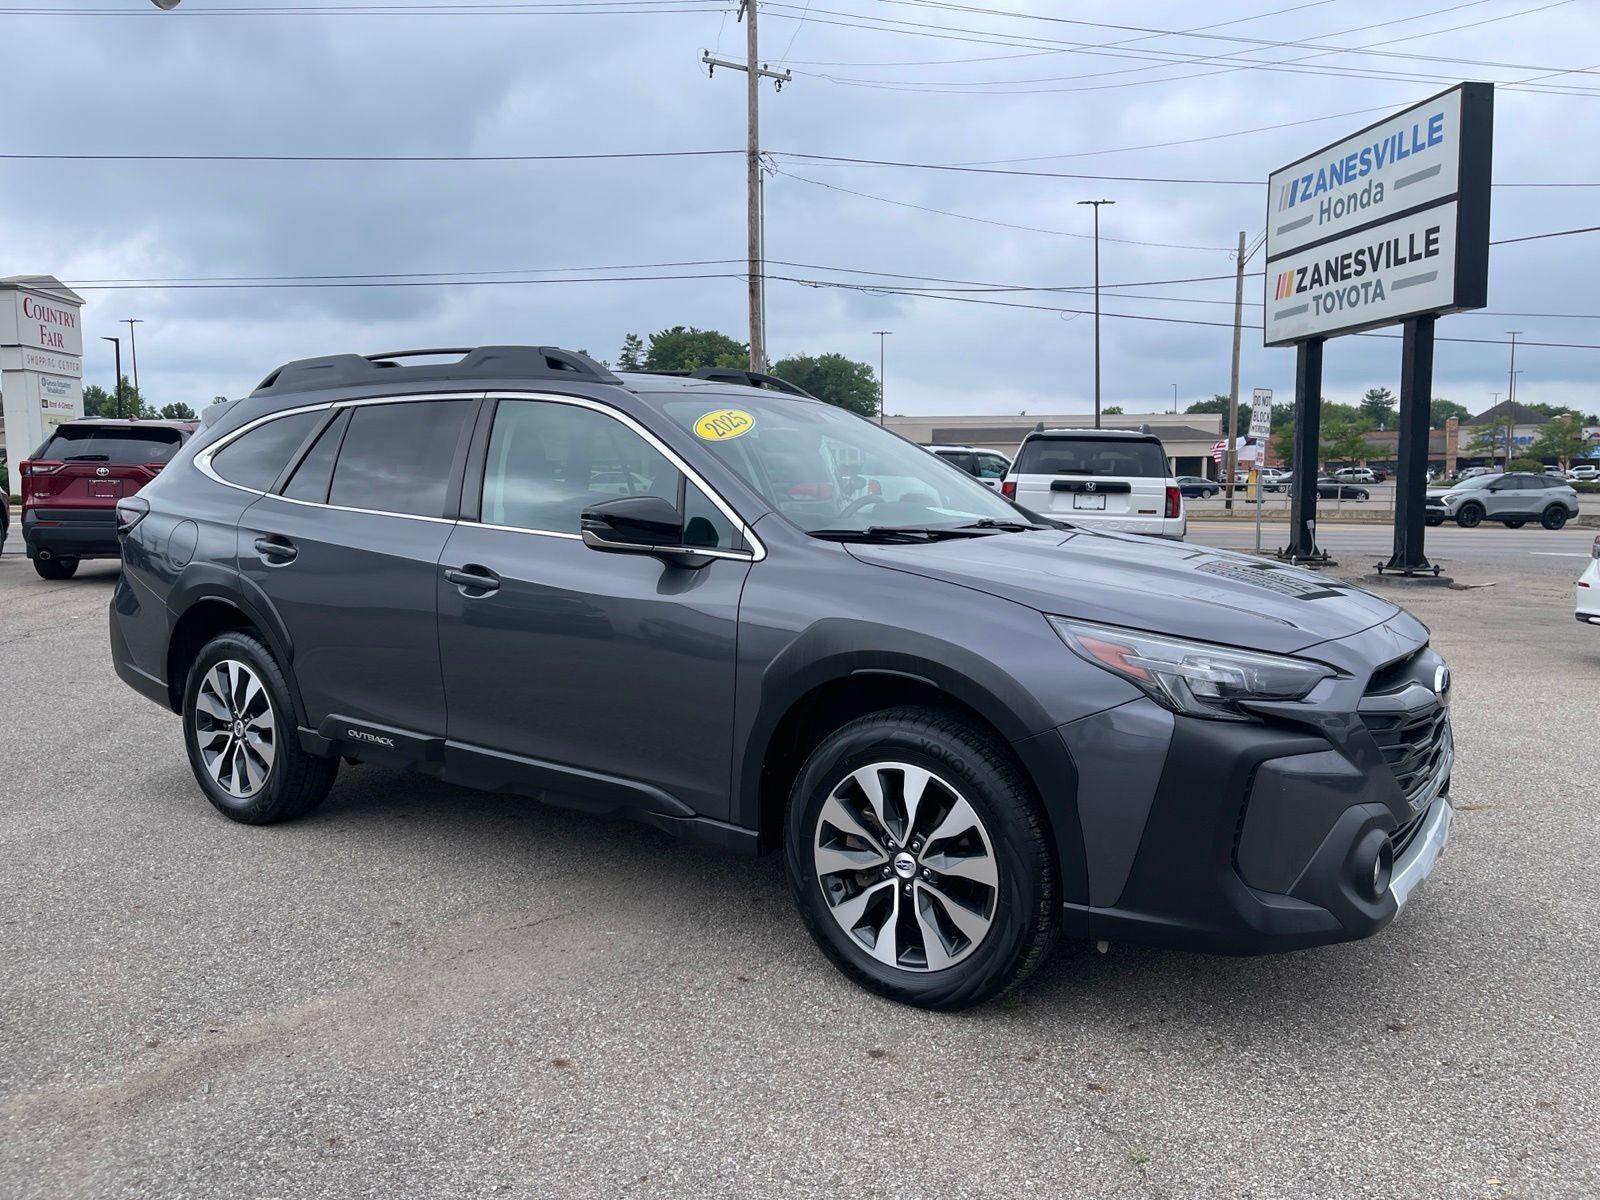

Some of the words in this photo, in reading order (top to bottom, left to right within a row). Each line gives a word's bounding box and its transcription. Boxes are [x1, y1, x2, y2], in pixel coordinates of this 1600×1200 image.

[1300, 112, 1444, 203] ZANESVILLE
[1319, 178, 1384, 225] Honda
[1296, 225, 1440, 294] ZANESVILLE
[1312, 278, 1386, 316] TOYOTA
[23, 296, 76, 328] COUNTRY
[39, 324, 64, 348] FAIR
[26, 354, 55, 369] SHOPPING
[58, 359, 80, 372] CENTER
[1253, 395, 1261, 406] DO
[1261, 395, 1271, 407] NOT
[704, 411, 748, 437] 2025
[1253, 411, 1271, 423] BLOCK
[347, 729, 394, 747] OUTBACK
